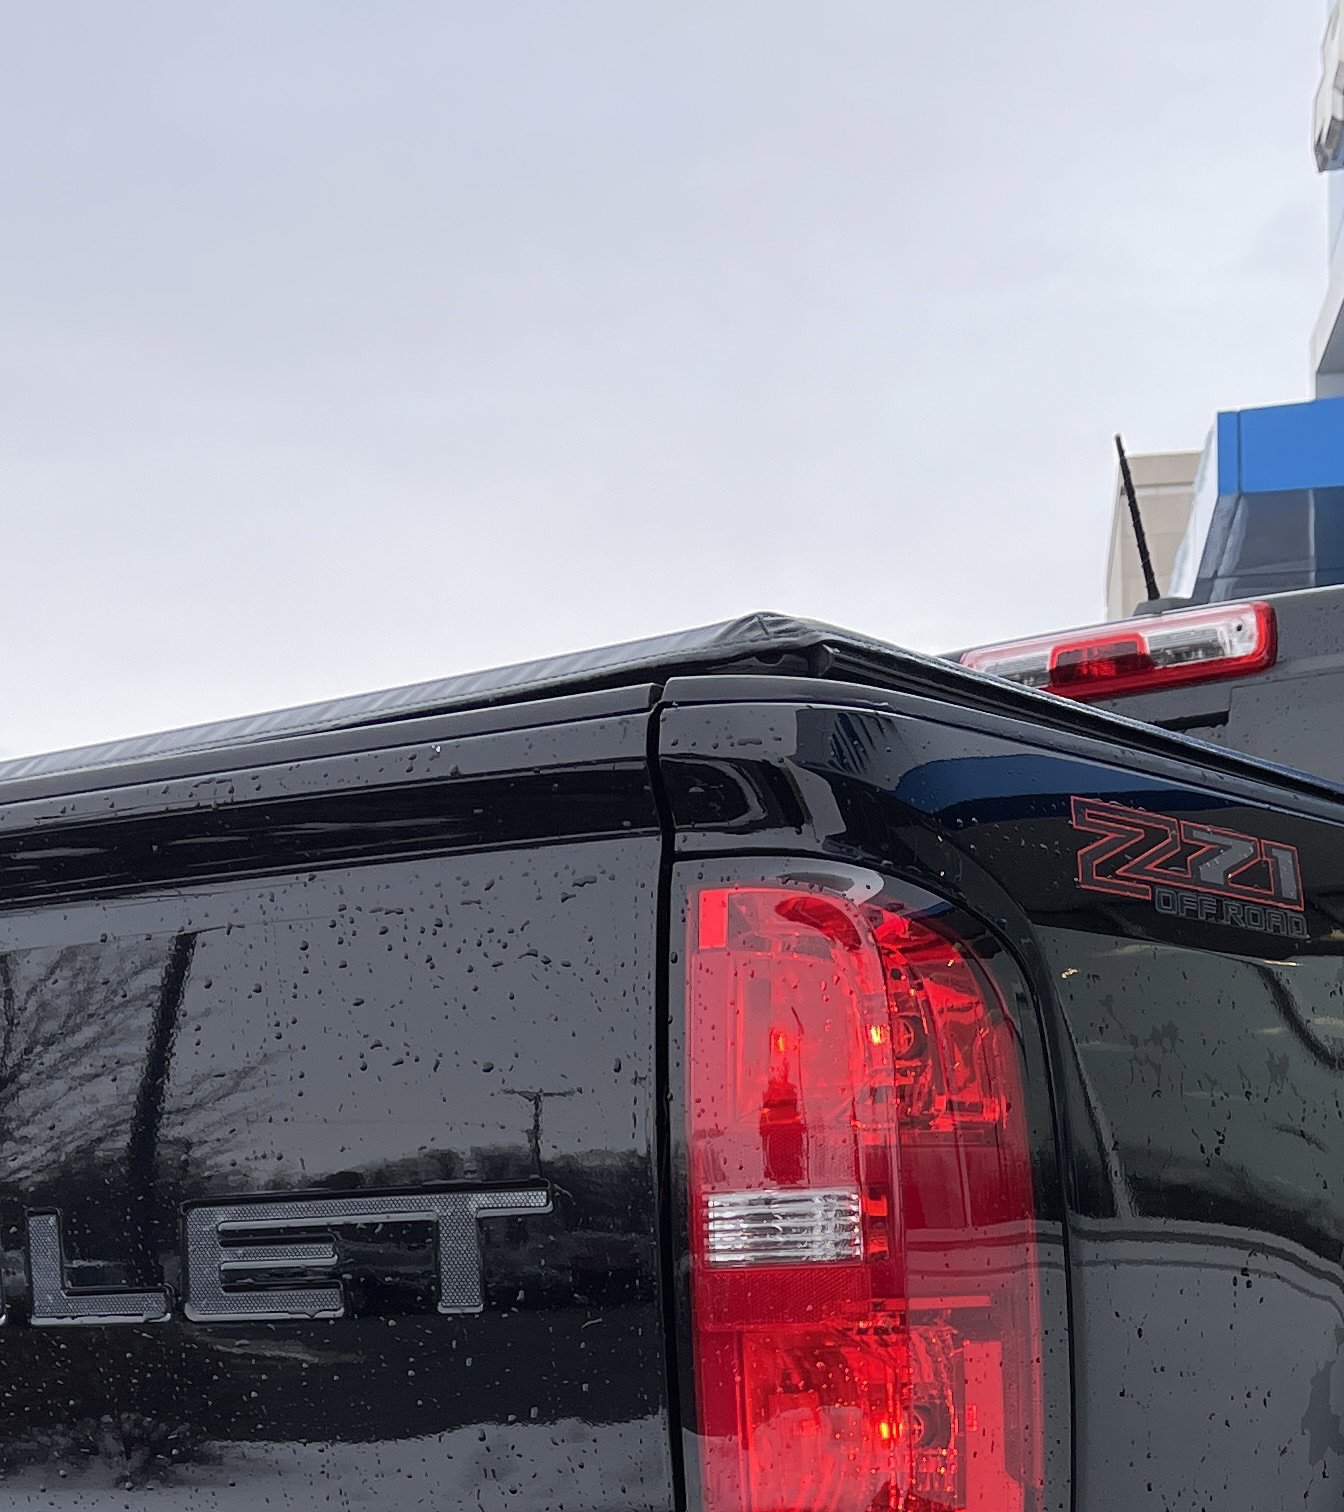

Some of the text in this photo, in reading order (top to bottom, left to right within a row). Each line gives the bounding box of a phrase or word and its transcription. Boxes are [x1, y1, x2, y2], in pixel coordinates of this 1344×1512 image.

[1070, 795, 1305, 912] Z71
[1155, 886, 1309, 940] OFF ROAD
